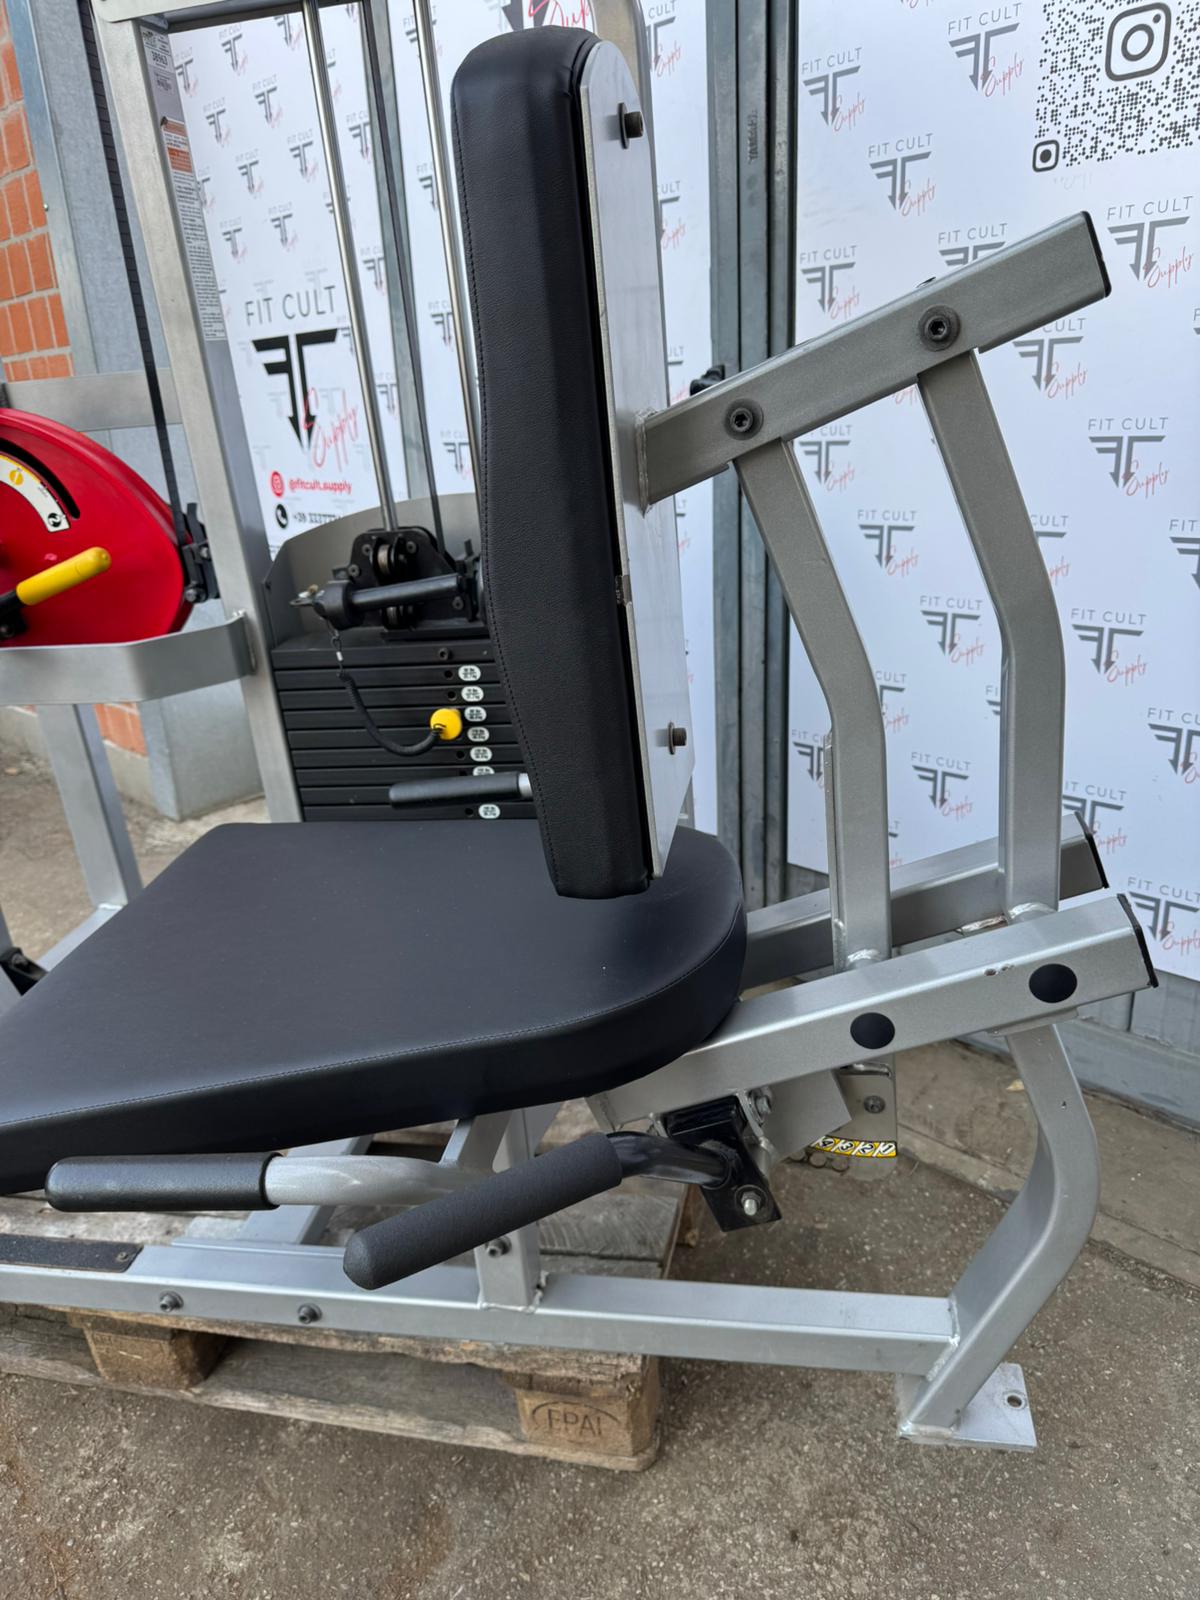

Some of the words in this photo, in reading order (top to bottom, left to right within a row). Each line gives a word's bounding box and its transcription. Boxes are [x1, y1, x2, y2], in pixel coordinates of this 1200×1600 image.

[948, 16, 972, 35] FIT
[979, 3, 1022, 26] CULT
[801, 59, 821, 75] FIT
[827, 47, 862, 67] CULT
[981, 52, 1024, 97] Supply
[868, 142, 890, 158] FIT
[895, 133, 933, 152] CULT
[1107, 205, 1135, 221] FIT
[1143, 196, 1193, 215] CULT
[937, 229, 960, 244] FIT
[967, 222, 1008, 240] CULT
[799, 250, 818, 264] FIT
[823, 245, 857, 260] CULT
[1143, 245, 1194, 288] Supply
[245, 297, 272, 326] FIT
[282, 285, 335, 320] CULT
[303, 387, 359, 472] Supply
[1088, 418, 1114, 431] FIT
[1121, 417, 1169, 430] CULT
[1122, 459, 1170, 499] Supply
[857, 509, 876, 520] FIT
[882, 510, 917, 521] CULT
[1169, 519, 1197, 532] FIT
[920, 595, 941, 606] FIT
[946, 598, 983, 611] CULT
[1071, 608, 1096, 621] FIT
[1102, 611, 1147, 625] CULT
[985, 685, 998, 696] FI
[1147, 707, 1175, 721] FIT
[911, 752, 931, 764] FIT
[936, 756, 971, 771] CULT
[1065, 781, 1079, 791] IT
[1085, 785, 1127, 801] CULT
[1128, 877, 1152, 890] FIT
